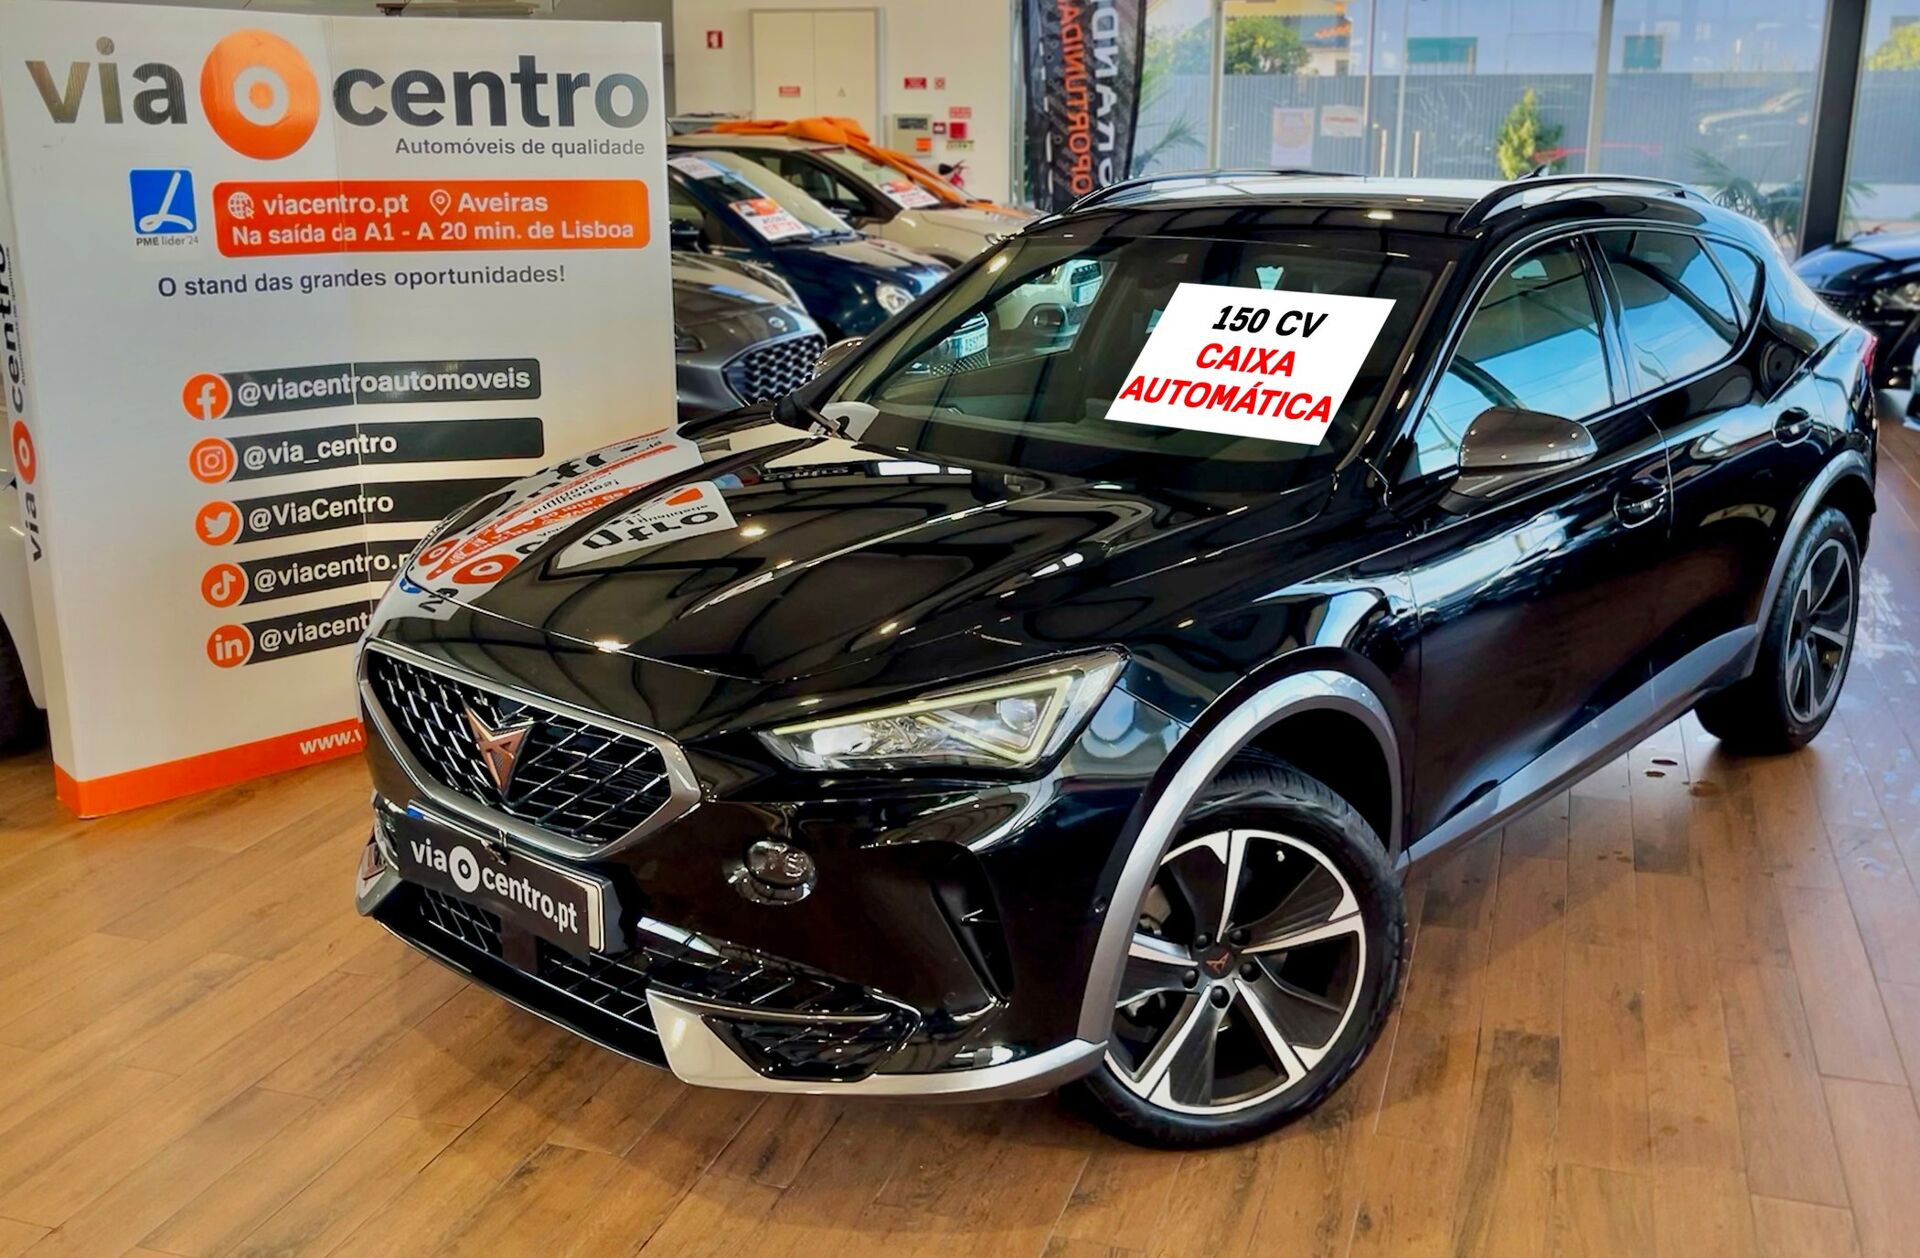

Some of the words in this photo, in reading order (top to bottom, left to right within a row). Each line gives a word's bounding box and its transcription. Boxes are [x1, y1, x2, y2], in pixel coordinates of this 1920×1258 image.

[25, 36, 188, 126] via
[333, 55, 649, 128] centro
[395, 137, 515, 155] Automóveis
[521, 139, 545, 155] de
[551, 139, 645, 158] qualidade
[263, 193, 409, 218] viacentro.pt
[458, 192, 549, 213] Aveiras
[136, 237, 159, 246] PME
[231, 226, 262, 246] Na
[268, 223, 326, 245] saída
[331, 223, 357, 242] da
[364, 222, 395, 241] A1
[416, 222, 435, 241] A
[440, 221, 467, 241] 20
[474, 221, 522, 240] min.
[527, 221, 555, 240] de
[561, 220, 635, 239] Lisboa
[158, 277, 177, 297] O
[185, 274, 248, 296] stand
[255, 273, 294, 292] das
[300, 269, 387, 294] grandes
[394, 265, 566, 290] oportunidades!
[238, 367, 531, 407] @viacentroautomoveis
[243, 433, 398, 471] @via_centro
[249, 494, 394, 533] @ViaCentro
[259, 611, 374, 653] @viacent
[410, 838, 448, 873] via
[481, 868, 579, 934] centro.pt
